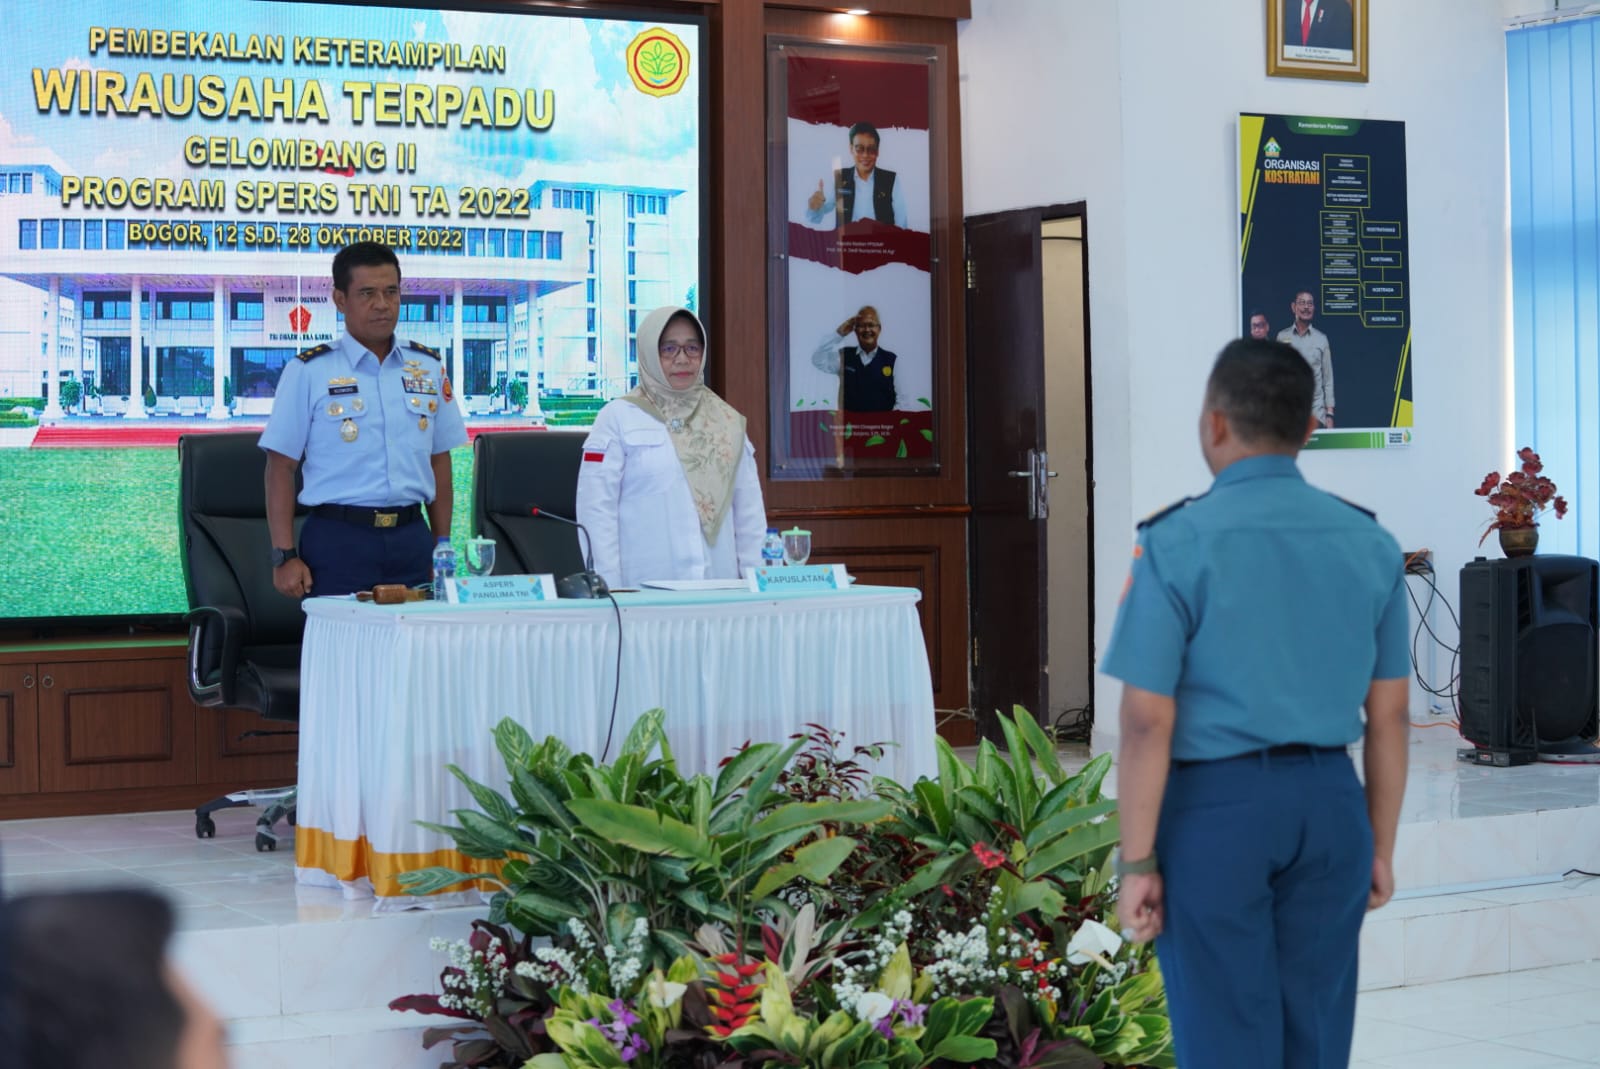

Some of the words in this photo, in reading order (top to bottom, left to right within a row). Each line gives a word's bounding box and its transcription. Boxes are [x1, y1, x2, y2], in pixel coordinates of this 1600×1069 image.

[89, 26, 284, 61] PEMBEKALAN
[293, 36, 506, 71] KETERAMPILAN
[32, 68, 329, 122] WIRAUSAHA
[343, 80, 555, 131] TERPADU
[184, 135, 387, 171] GELOMBANG
[396, 142, 417, 172] II
[1264, 158, 1320, 170] ORGANISASI
[1264, 169, 1320, 184] KOSTRATANI
[61, 175, 226, 209] PROGRAM
[236, 180, 338, 213] SPERS
[348, 184, 400, 215] TNI
[410, 186, 451, 216] TA
[458, 186, 531, 218] 2022
[128, 222, 208, 246] BOGOR,
[215, 225, 238, 243] 12
[244, 226, 281, 244] S.D.
[288, 227, 311, 245] 28
[317, 227, 411, 247] OKTOBER
[417, 230, 463, 247] 2022
[767, 575, 825, 584] KAPUSLATAN
[472, 591, 514, 599] PANGLIMA
[514, 590, 529, 598] TNI
